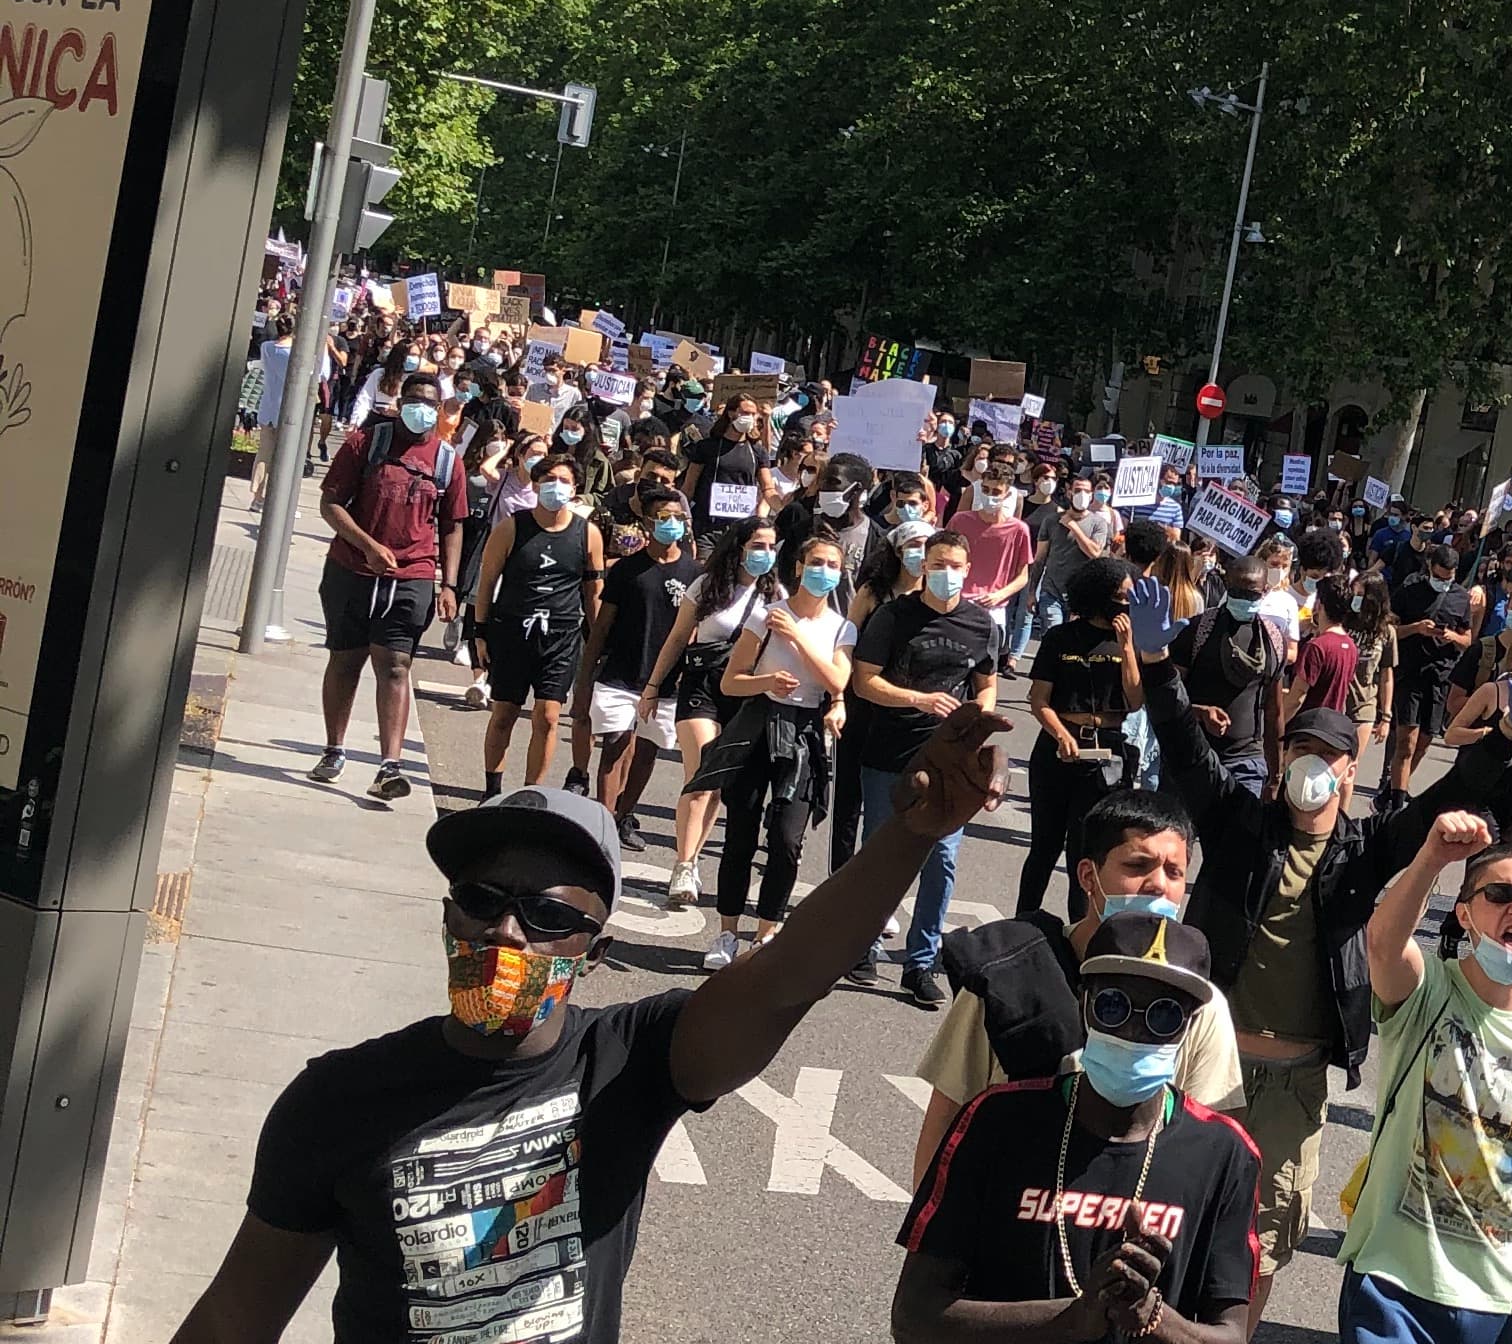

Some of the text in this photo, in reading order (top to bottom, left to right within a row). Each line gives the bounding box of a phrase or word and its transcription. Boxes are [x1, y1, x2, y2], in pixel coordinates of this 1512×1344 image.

[863, 350, 917, 379] LIVES
[868, 336, 921, 364] BLACK
[1204, 488, 1264, 532] MARGINAR
